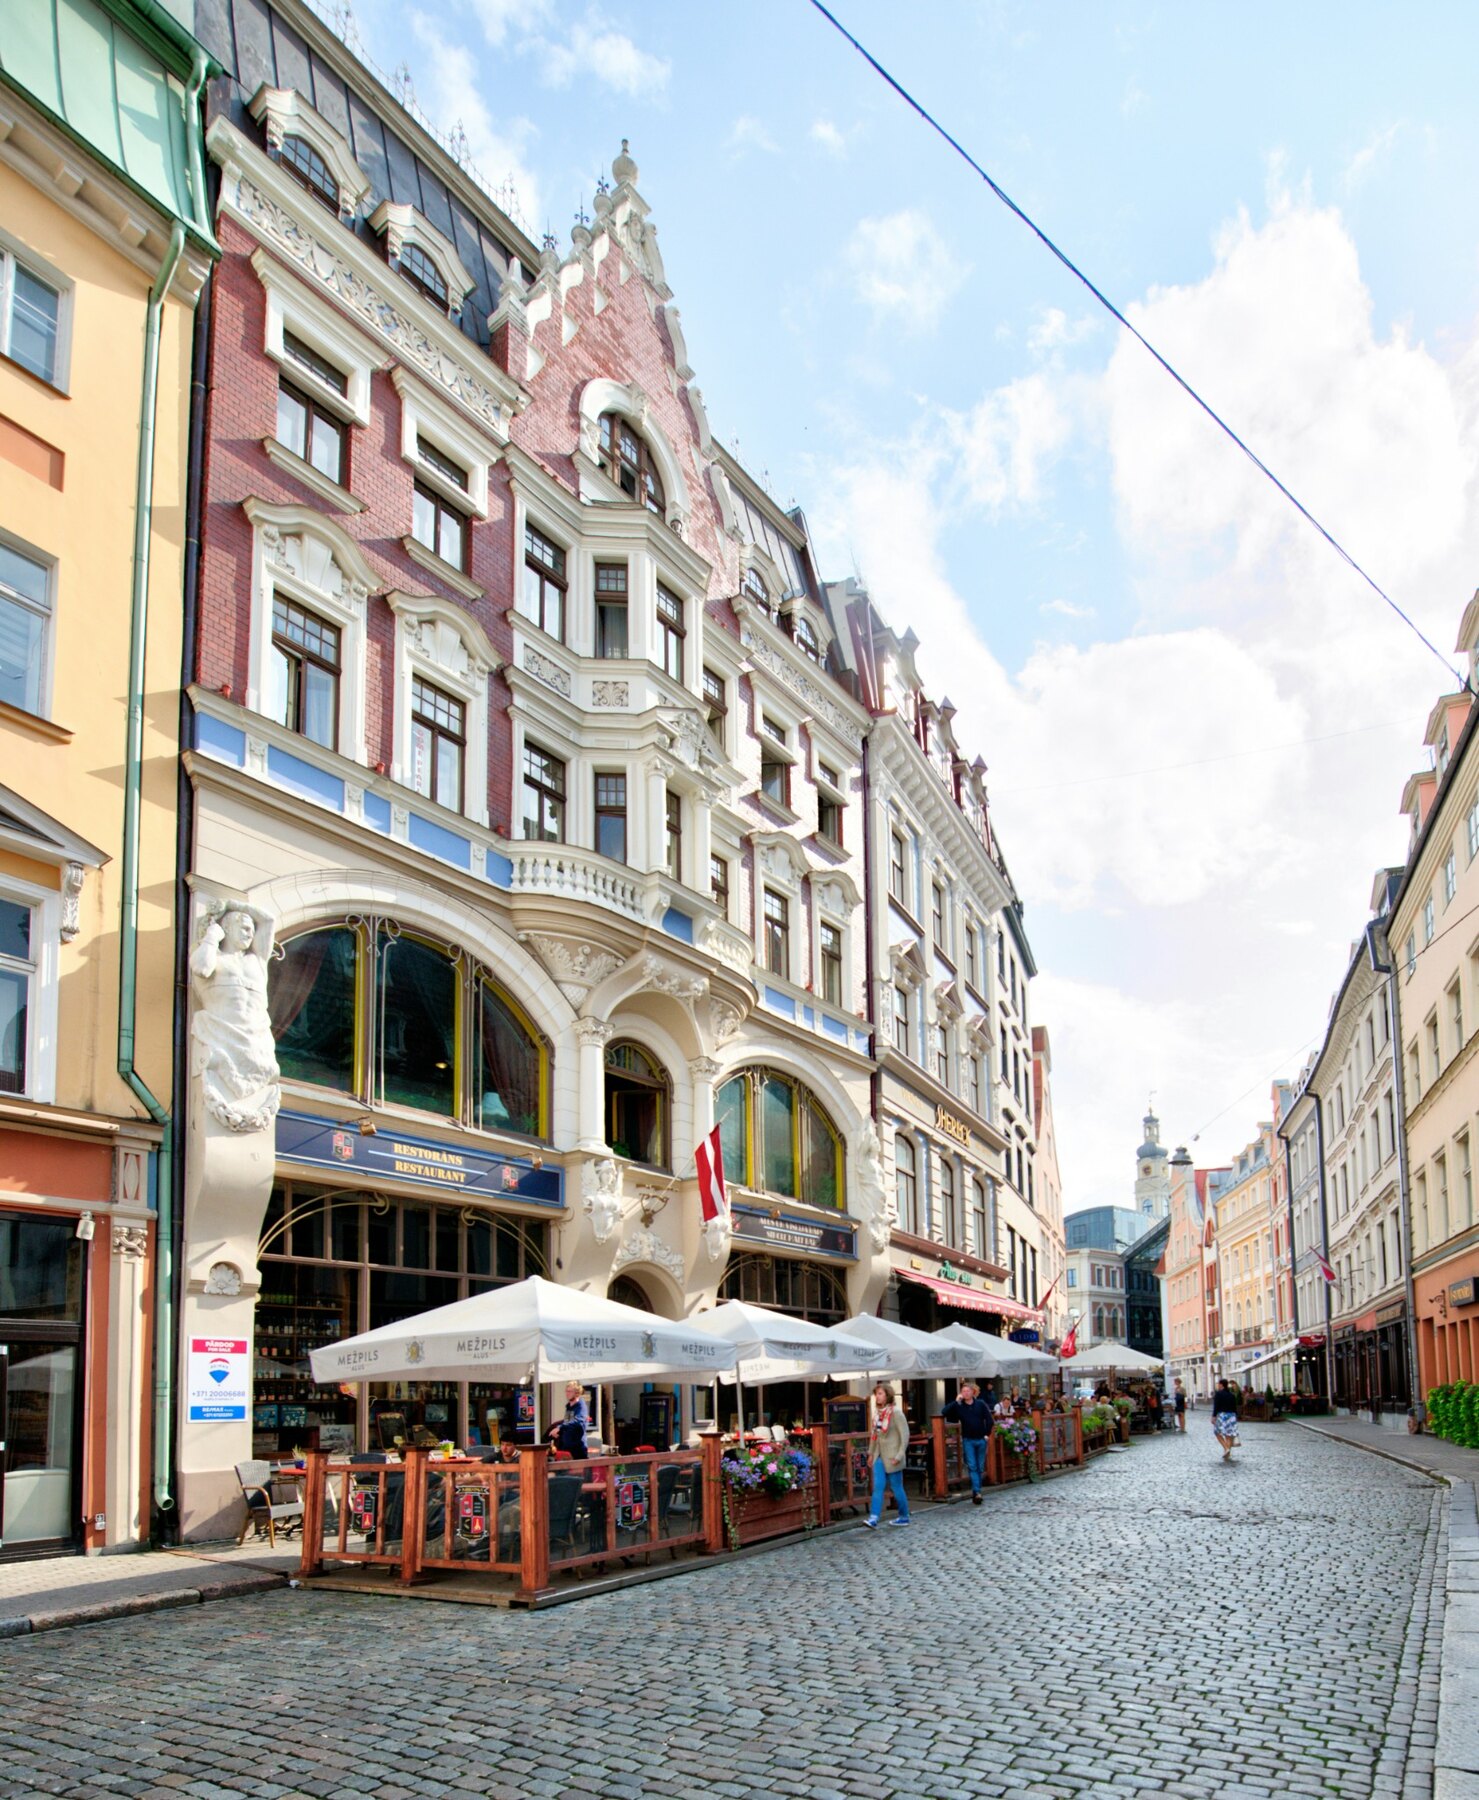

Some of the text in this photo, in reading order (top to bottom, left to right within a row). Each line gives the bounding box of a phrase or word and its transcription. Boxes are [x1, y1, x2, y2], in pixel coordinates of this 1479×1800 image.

[393, 1143, 463, 1165] RESTORĀNS
[395, 1160, 466, 1183] RESTAURANT
[456, 1337, 506, 1352] MEŽPILS
[574, 1335, 617, 1349] MEŽPILS
[682, 1342, 716, 1356] MEŽPILS
[337, 1350, 379, 1366] MEŽPILS
